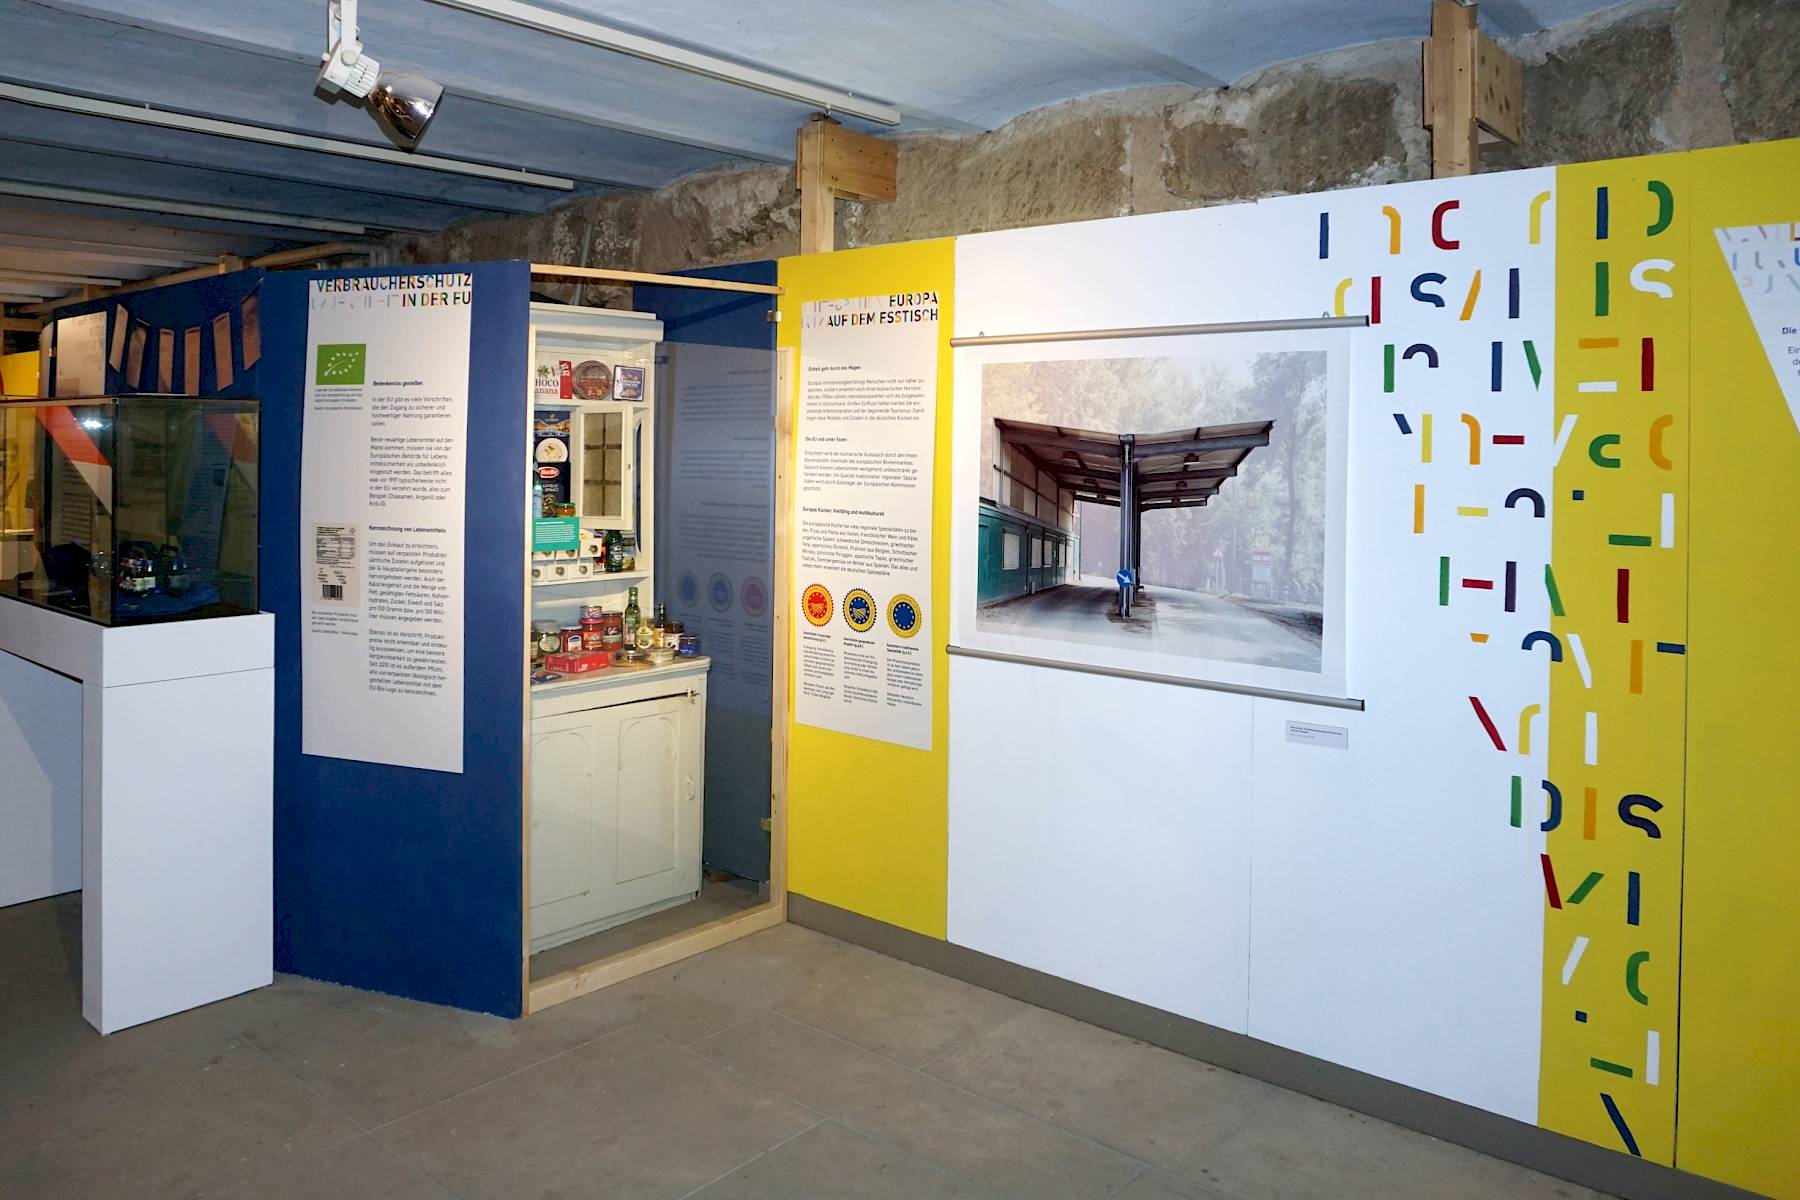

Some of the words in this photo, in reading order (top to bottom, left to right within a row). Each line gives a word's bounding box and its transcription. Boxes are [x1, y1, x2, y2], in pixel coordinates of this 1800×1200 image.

[317, 273, 471, 292] VERBRAUCHERSCHUTZ
[402, 293, 416, 306] IN
[421, 292, 448, 306] DER
[889, 292, 938, 307] EUROPA
[828, 314, 848, 327] AUF
[852, 312, 876, 326] DEM
[880, 308, 938, 324] ESSTISCH
[534, 378, 559, 387] HOCO
